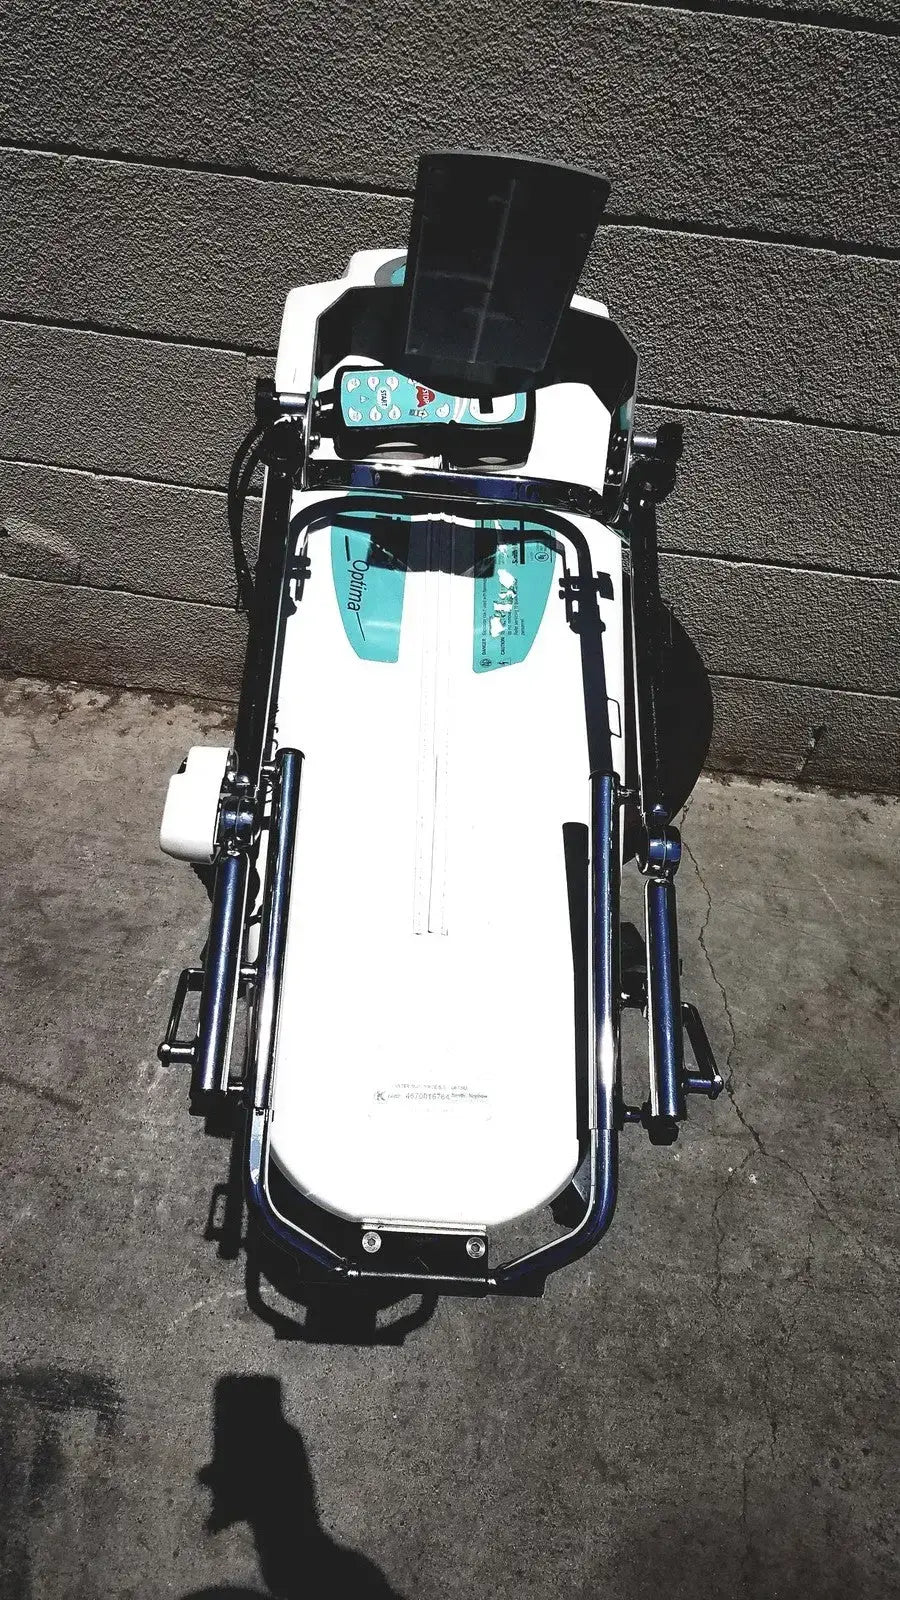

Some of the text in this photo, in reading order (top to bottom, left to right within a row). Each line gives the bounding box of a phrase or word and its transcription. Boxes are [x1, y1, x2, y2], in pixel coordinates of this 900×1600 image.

[380, 389, 388, 407] START
[422, 388, 430, 405] STOP
[347, 560, 370, 611] Optima
